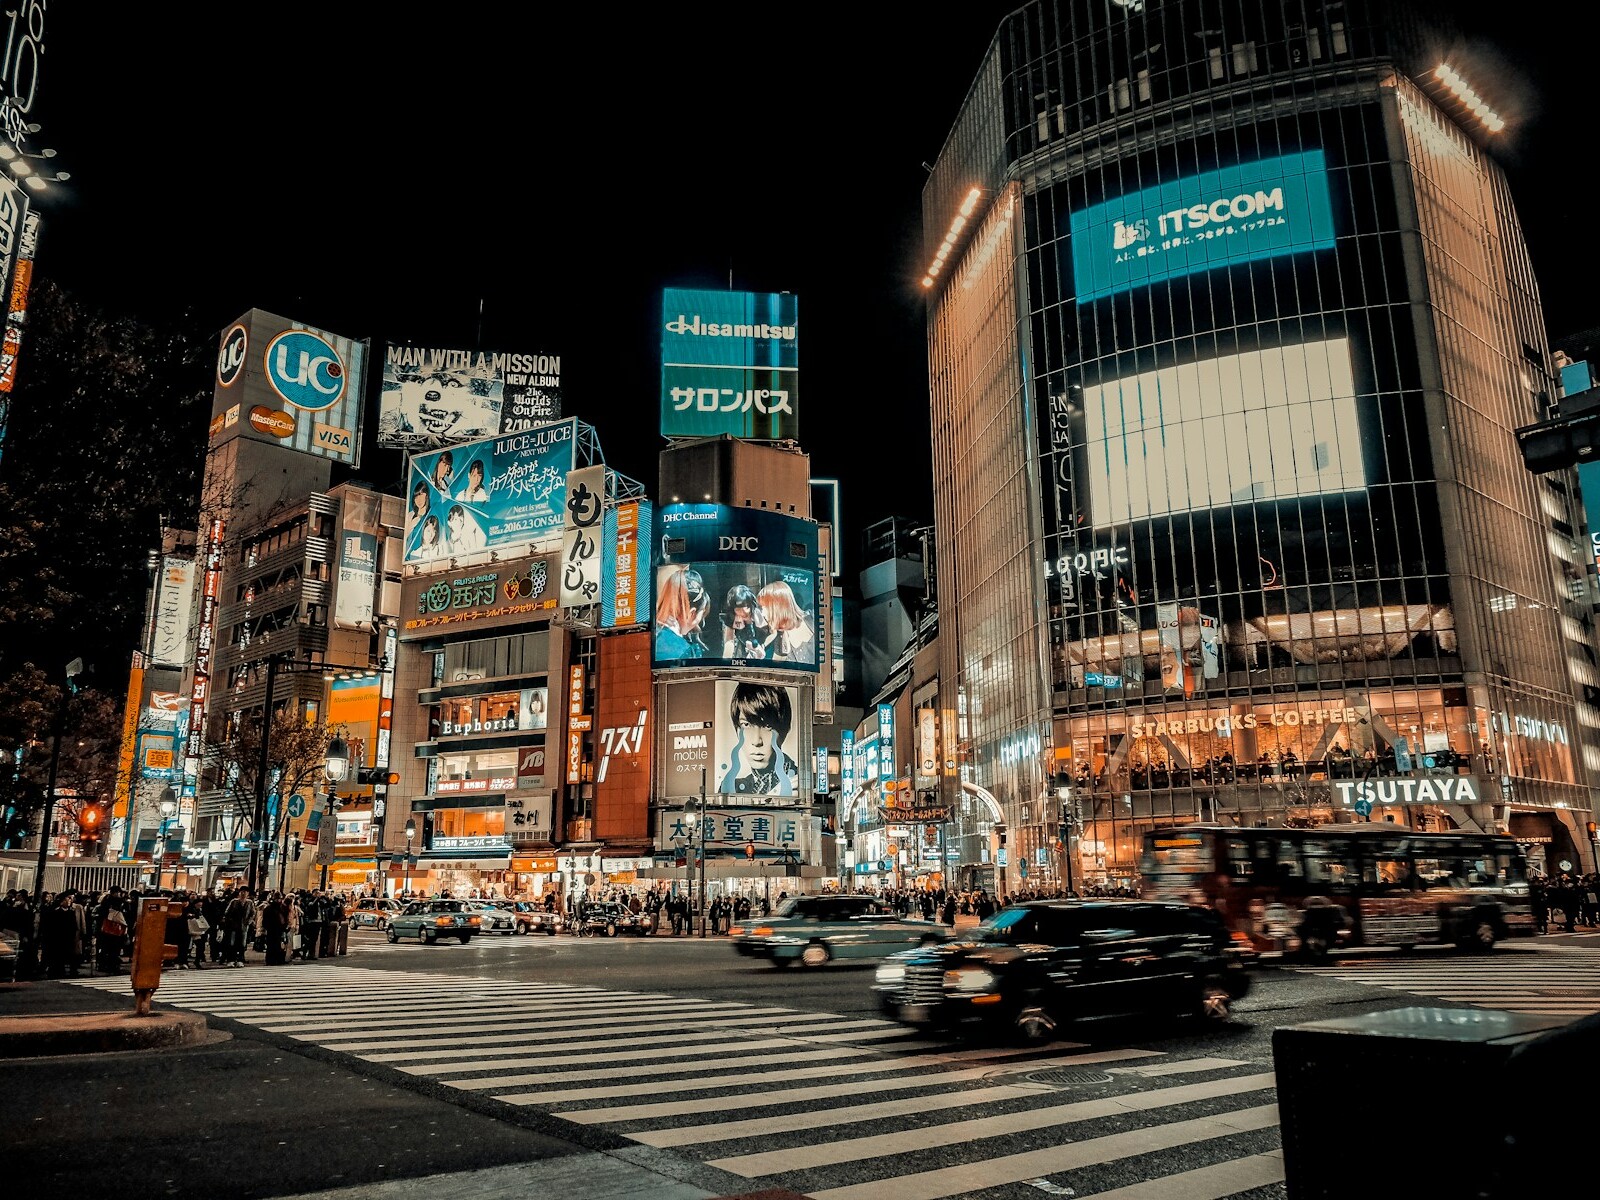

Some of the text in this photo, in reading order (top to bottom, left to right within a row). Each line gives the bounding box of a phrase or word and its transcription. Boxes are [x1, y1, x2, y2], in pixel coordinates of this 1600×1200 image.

[1158, 187, 1284, 237] ITSCOM
[665, 315, 796, 340] Hisamitsu
[387, 346, 561, 375] MAN WITH A MISSION
[506, 373, 559, 387] NEW ALBUM
[525, 387, 544, 397] The
[670, 386, 793, 415] サロンパス
[250, 413, 295, 431] MasterCard
[504, 418, 532, 433] 2/10
[319, 430, 350, 448] VISA
[513, 505, 528, 514] Next
[663, 511, 717, 523] DHC Channel
[504, 519, 534, 533] 2016.2.3
[534, 517, 547, 528] ON
[548, 513, 564, 525] SAL
[567, 482, 601, 601] もんじゃ
[718, 536, 759, 552] DHC
[616, 508, 633, 618] 三千里薬品
[453, 583, 496, 609] 西村
[443, 717, 516, 737] Euphoria
[1132, 707, 1356, 739] STARBUCKS COFFEE
[597, 710, 647, 783] クスリ
[673, 735, 708, 750] DMM
[520, 751, 545, 771] JTB
[673, 748, 708, 762] mobile
[676, 763, 705, 773] のスマホ
[1336, 777, 1477, 804] TSUTAYA
[669, 817, 796, 842] 大盛堂書店
